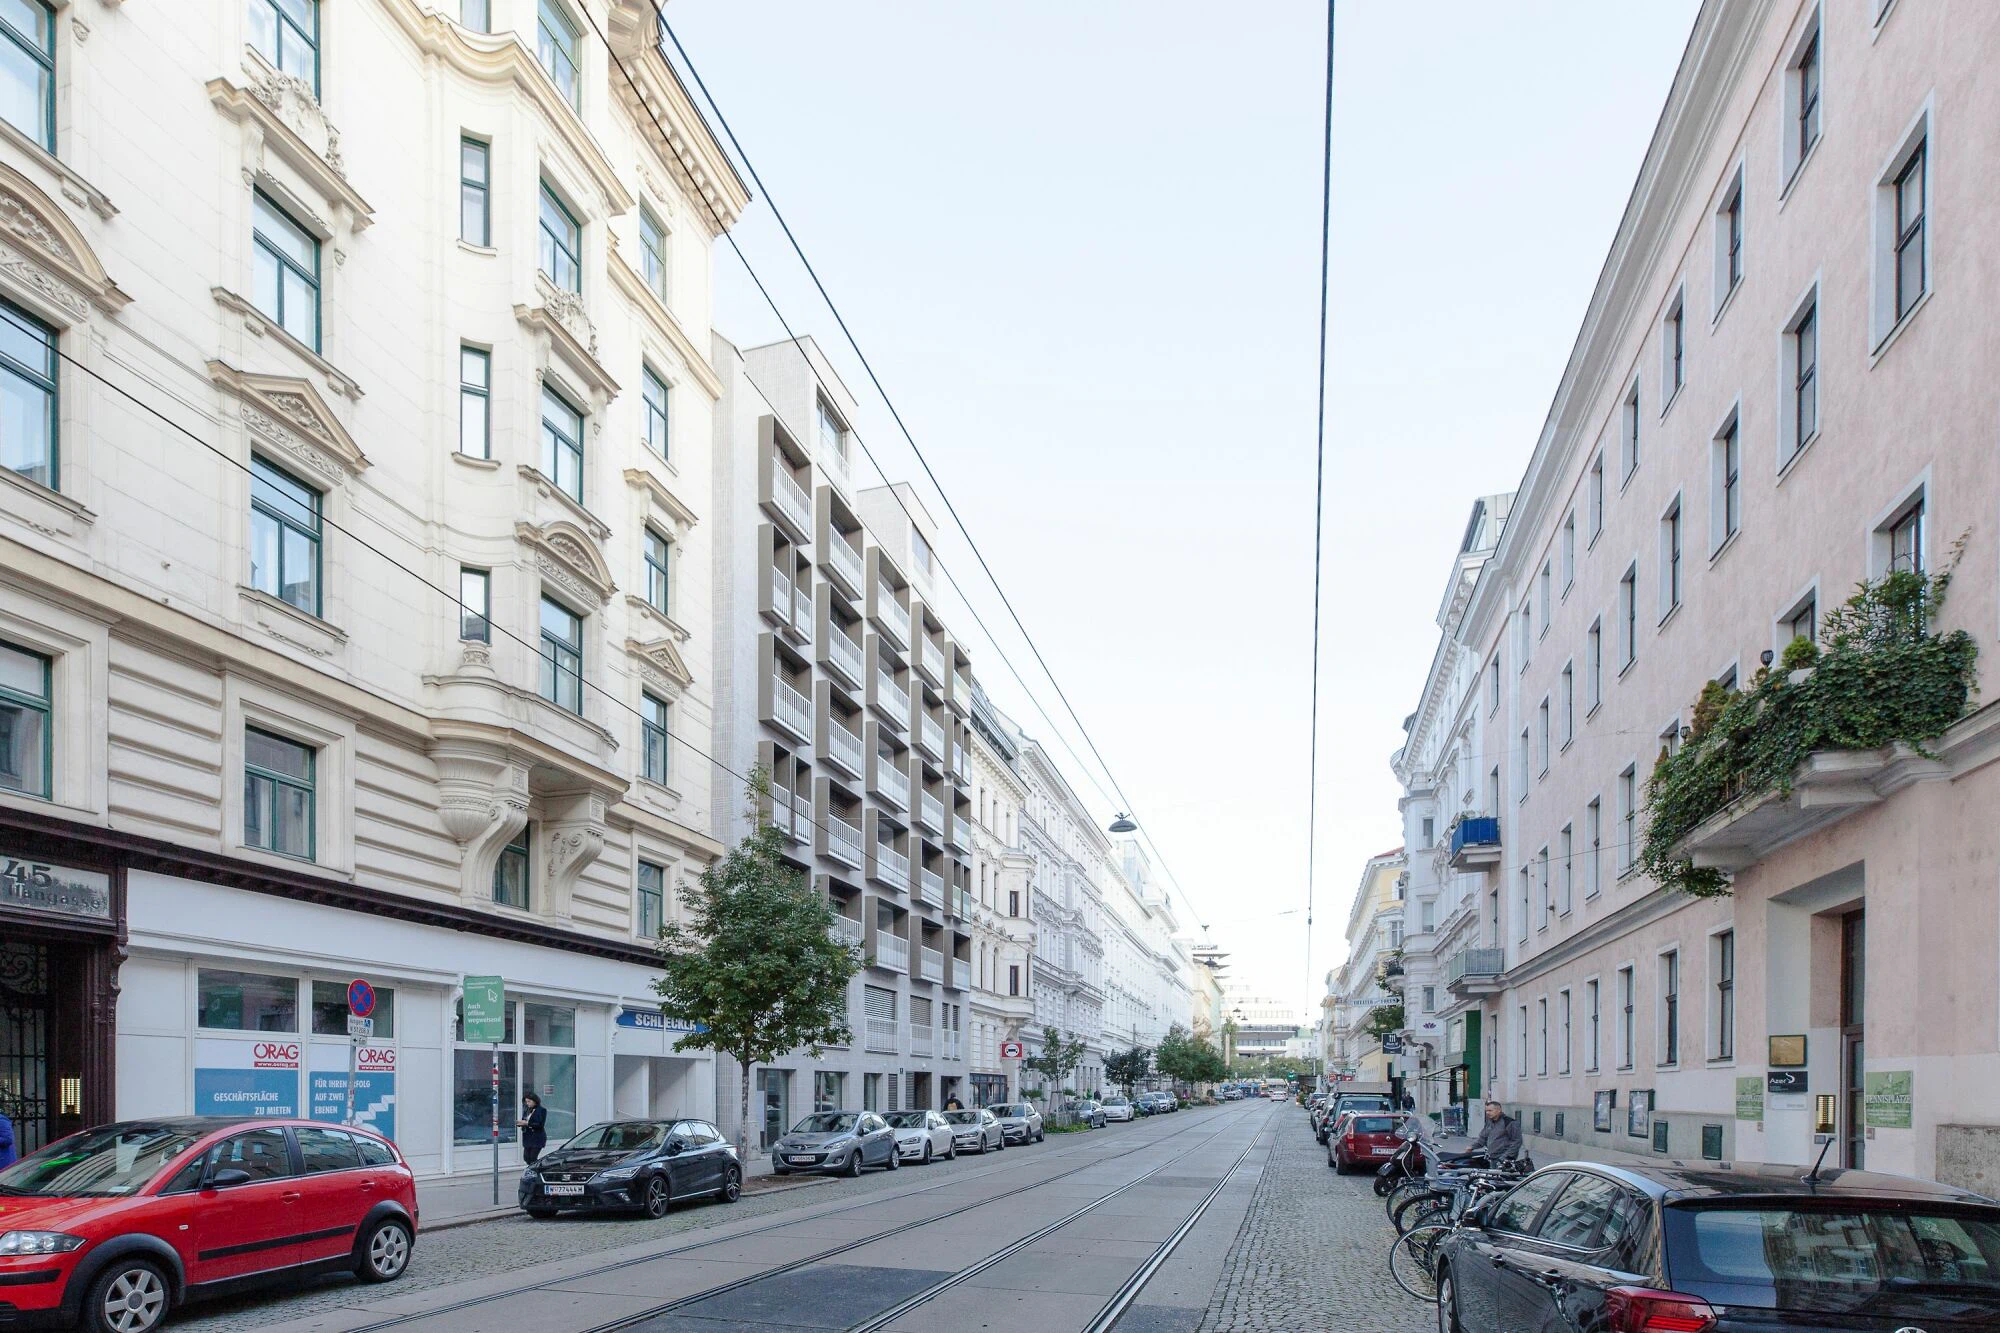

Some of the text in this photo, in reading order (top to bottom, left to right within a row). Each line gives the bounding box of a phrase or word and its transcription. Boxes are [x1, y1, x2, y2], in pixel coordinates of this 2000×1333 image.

[4, 860, 51, 888] 45
[314, 1078, 327, 1088] FÜR
[328, 1080, 348, 1088] IHREN
[213, 1091, 279, 1102] GESCHÄFTSFLÄCHE
[314, 1092, 345, 1102] AUF ZWEI
[254, 1107, 291, 1115] ZU MIETEN
[314, 1106, 338, 1115] EBENEN
